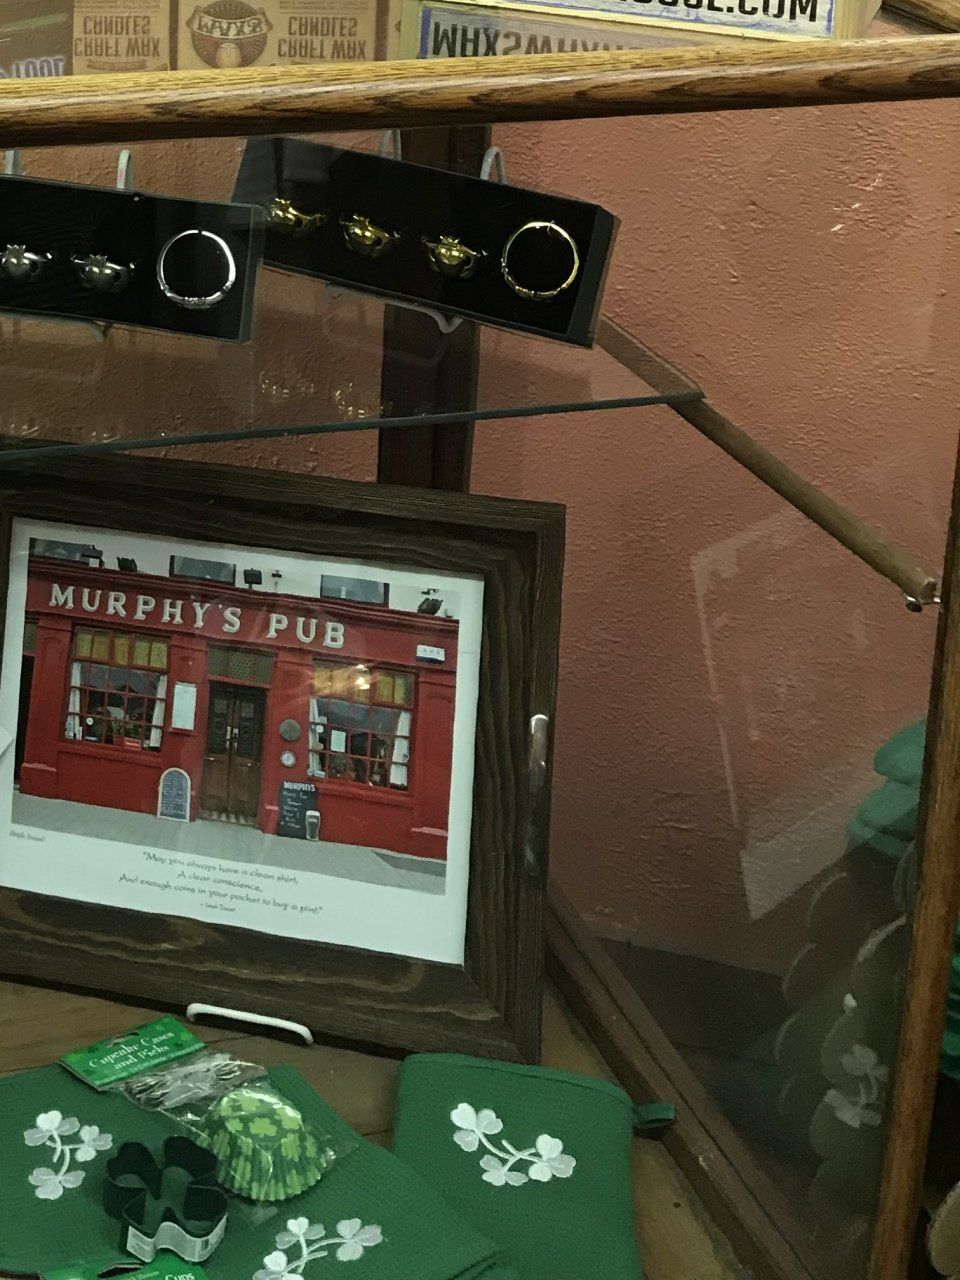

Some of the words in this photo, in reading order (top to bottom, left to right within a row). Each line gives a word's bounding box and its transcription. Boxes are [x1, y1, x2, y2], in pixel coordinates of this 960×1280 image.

[48, 582, 243, 634] MURPHY'S
[265, 612, 346, 650] PUB
[176, 869, 187, 880] A
[188, 872, 211, 882] clear
[212, 876, 264, 894] conscience,
[186, 860, 217, 873] always
[219, 864, 239, 874] have
[249, 868, 275, 880] clean
[118, 873, 139, 884] And
[139, 877, 172, 892] enough
[173, 883, 196, 894] coins
[198, 885, 207, 895] in
[208, 889, 228, 899] your
[229, 891, 260, 905] pocket
[262, 896, 271, 905] to
[272, 898, 289, 911] buy
[89, 1042, 140, 1068] Cupcake
[139, 1031, 176, 1047] Cases
[114, 1054, 138, 1070] and
[138, 1044, 171, 1060] Picks
